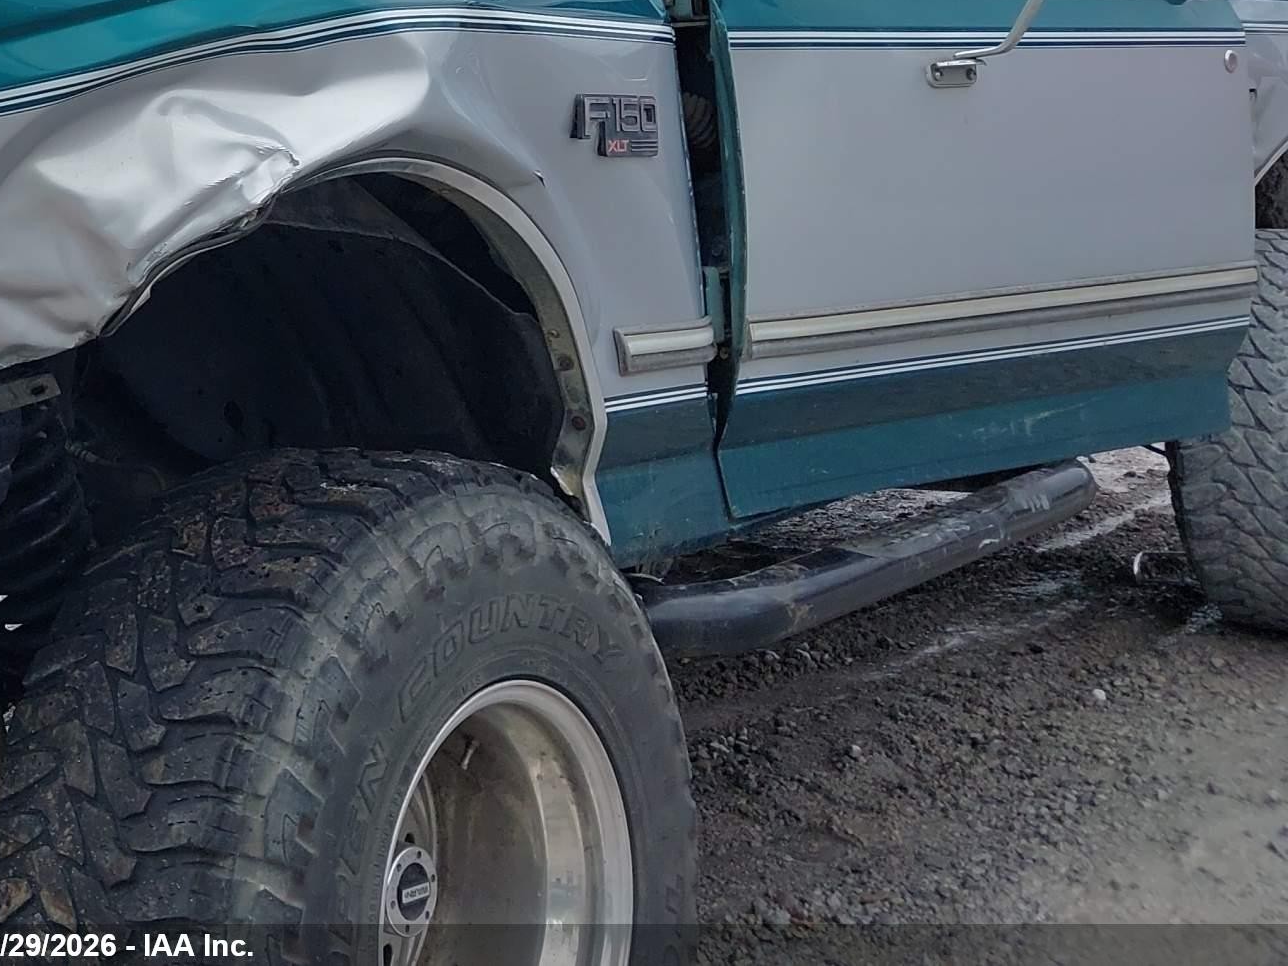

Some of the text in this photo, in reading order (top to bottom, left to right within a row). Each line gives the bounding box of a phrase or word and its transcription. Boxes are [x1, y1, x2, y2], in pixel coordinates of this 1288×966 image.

[572, 94, 658, 139] F150
[607, 139, 630, 153] XLT
[397, 593, 624, 724] COUNTRY
